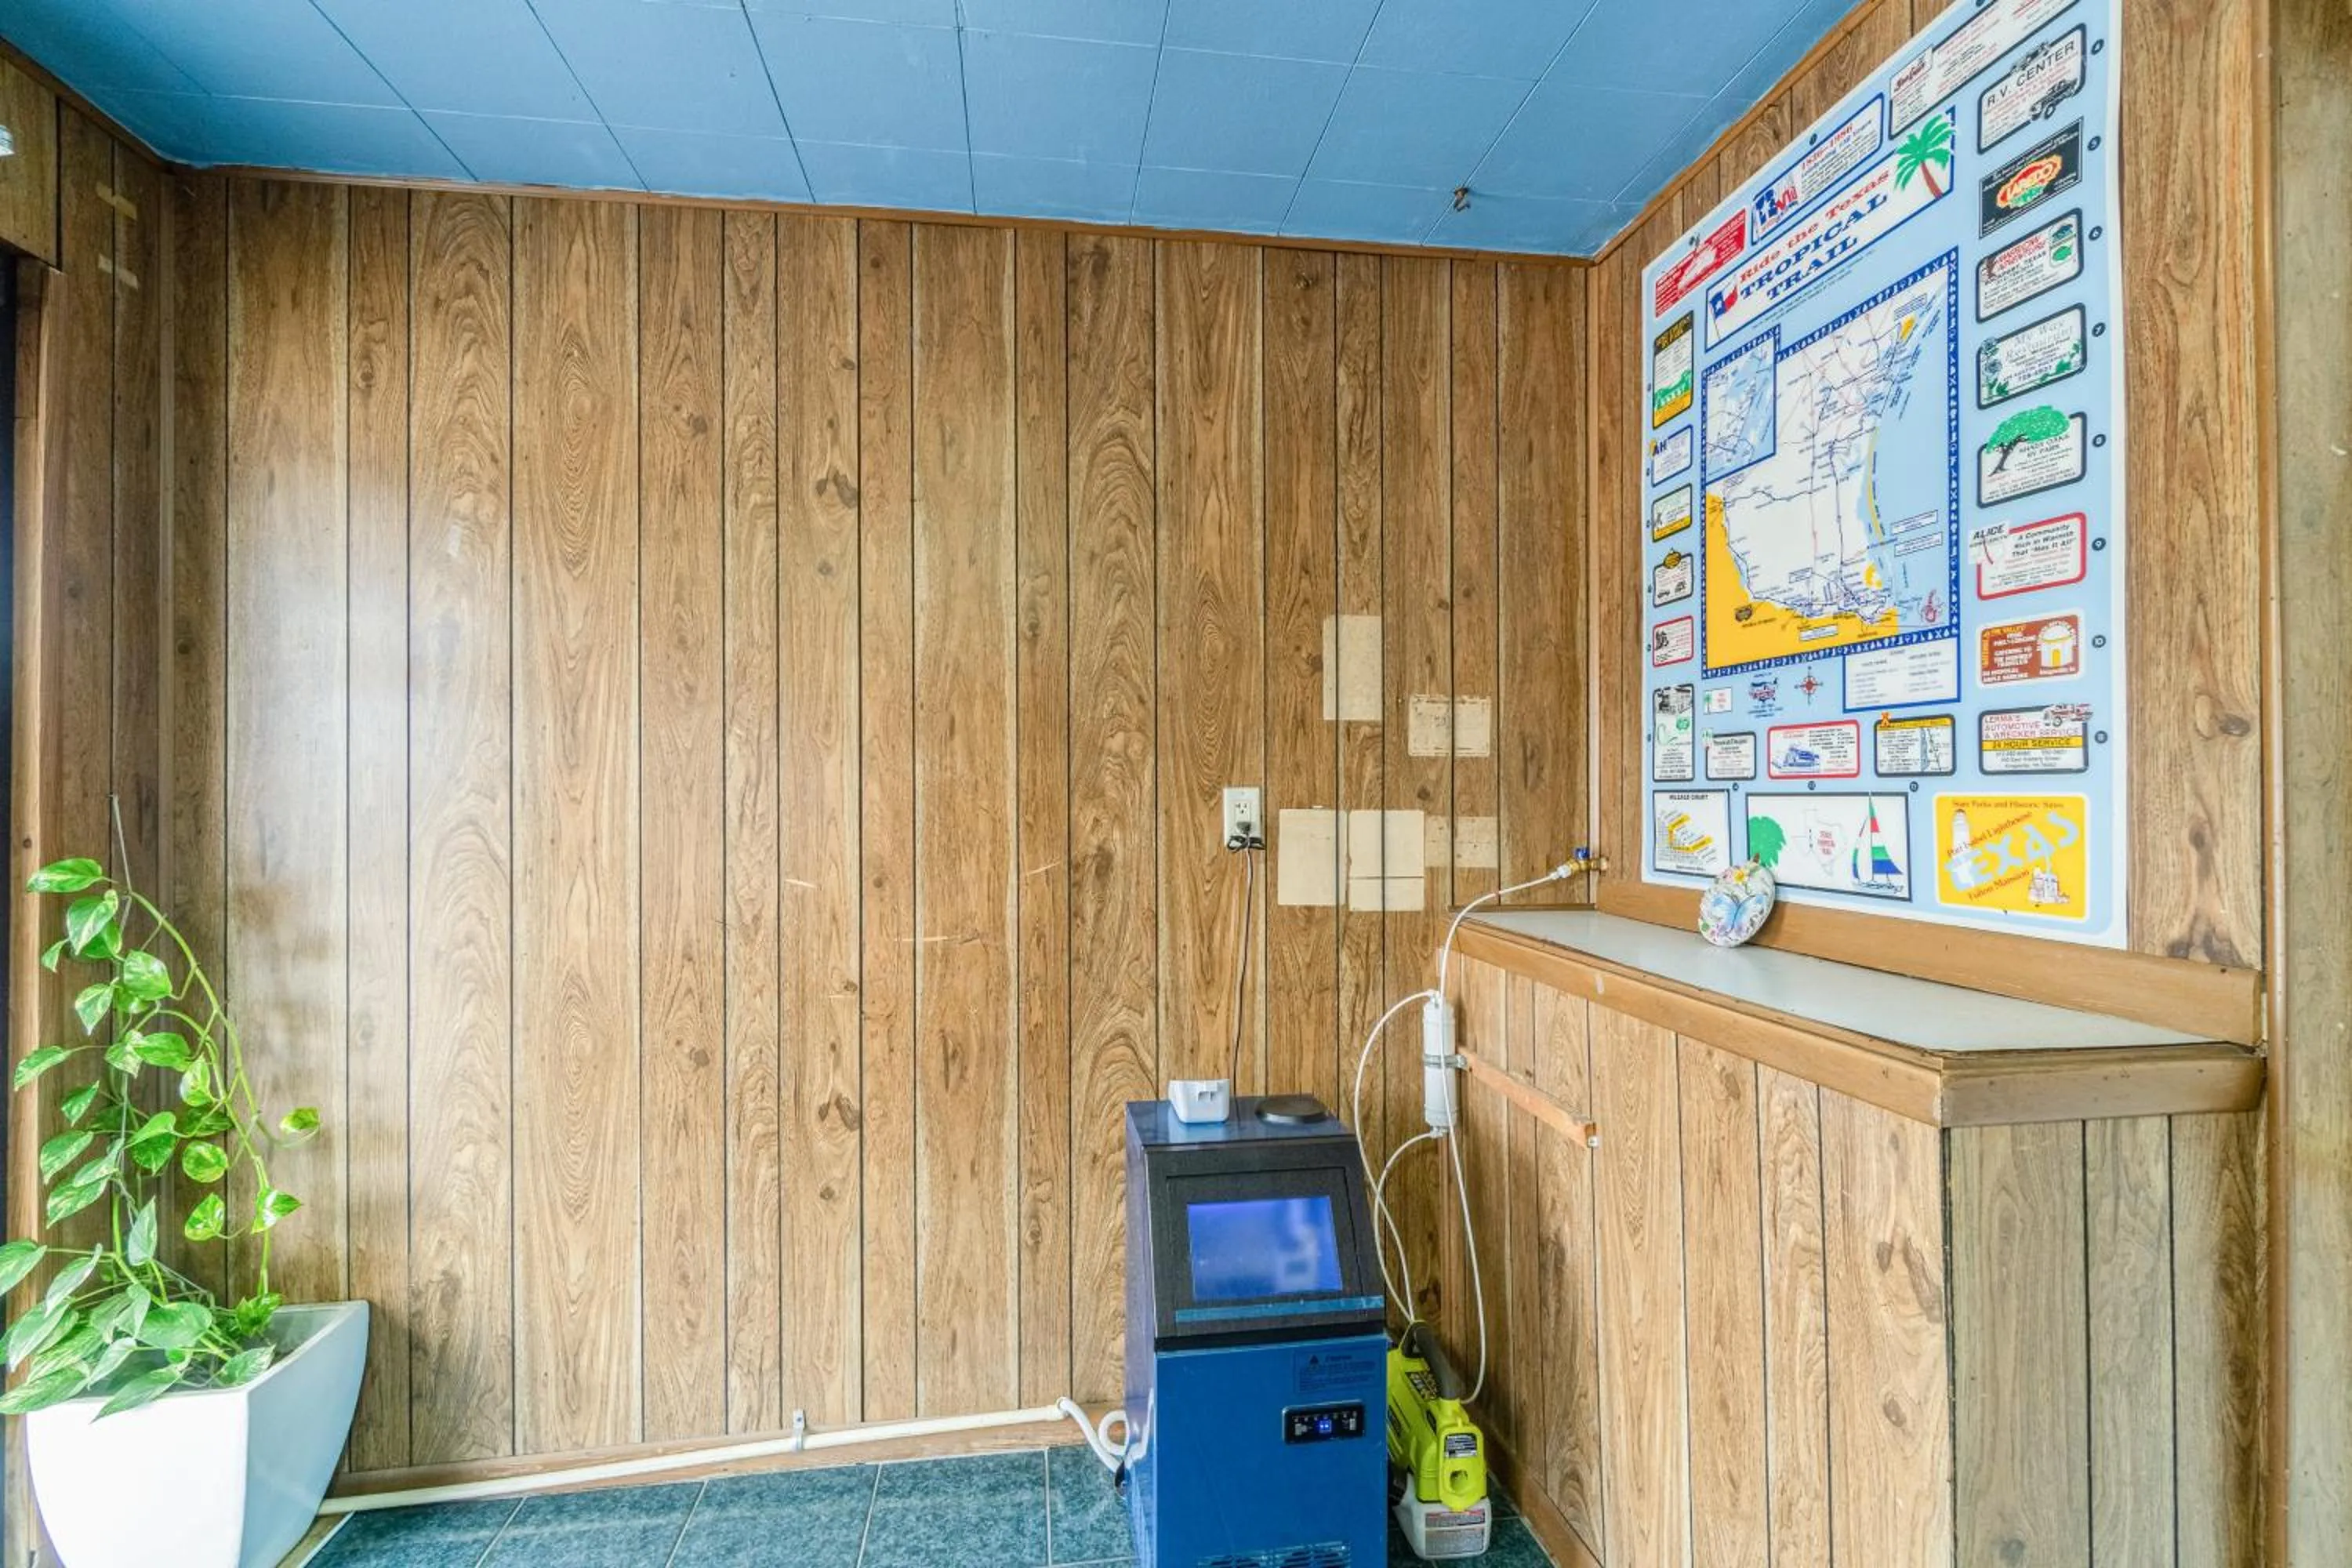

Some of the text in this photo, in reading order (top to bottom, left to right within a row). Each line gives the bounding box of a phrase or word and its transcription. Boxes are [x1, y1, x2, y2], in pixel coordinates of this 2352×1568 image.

[1987, 84, 2012, 107] R.V.
[2016, 40, 2075, 87] CENTER
[1739, 250, 1780, 283] Ride
[1787, 222, 1819, 249] the
[1825, 170, 1889, 220] Texas
[1740, 193, 1888, 299] TROPICAL
[1766, 235, 1858, 300] TRAIL
[1973, 523, 2006, 539] ALICE
[2025, 524, 2071, 539] Community
[2042, 531, 2074, 543] Warmth
[1984, 720, 2041, 731] AUTOMOTIVE
[2031, 738, 2071, 747] SERVICE
[1986, 811, 2033, 839] Lighthouse
[1944, 811, 2079, 892] TEXAS
